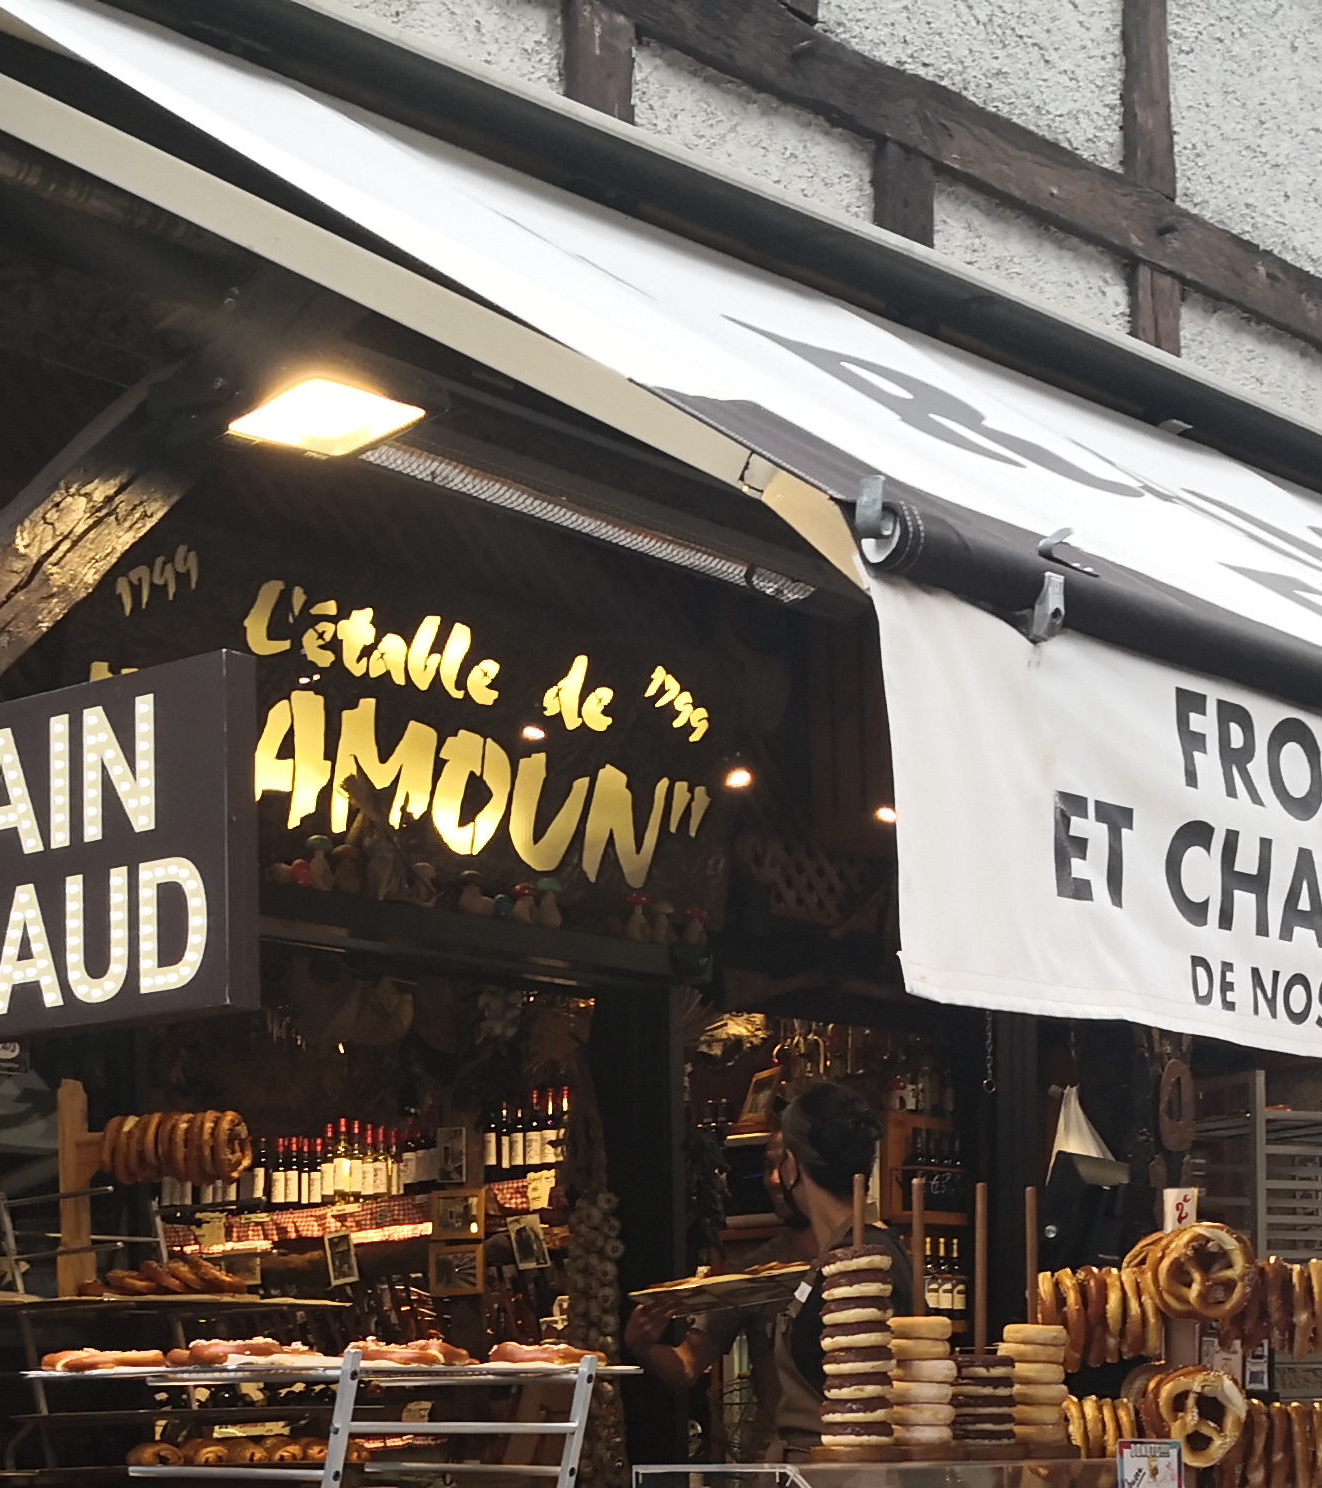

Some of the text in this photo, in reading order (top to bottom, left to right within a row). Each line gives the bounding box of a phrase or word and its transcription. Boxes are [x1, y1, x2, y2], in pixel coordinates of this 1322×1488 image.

[115, 544, 200, 617] 1799
[243, 580, 500, 706] L'étable
[543, 655, 614, 732] de
[254, 690, 713, 889] AMOUN"
[1053, 789, 1134, 908] ET
[1190, 954, 1236, 1012] DE
